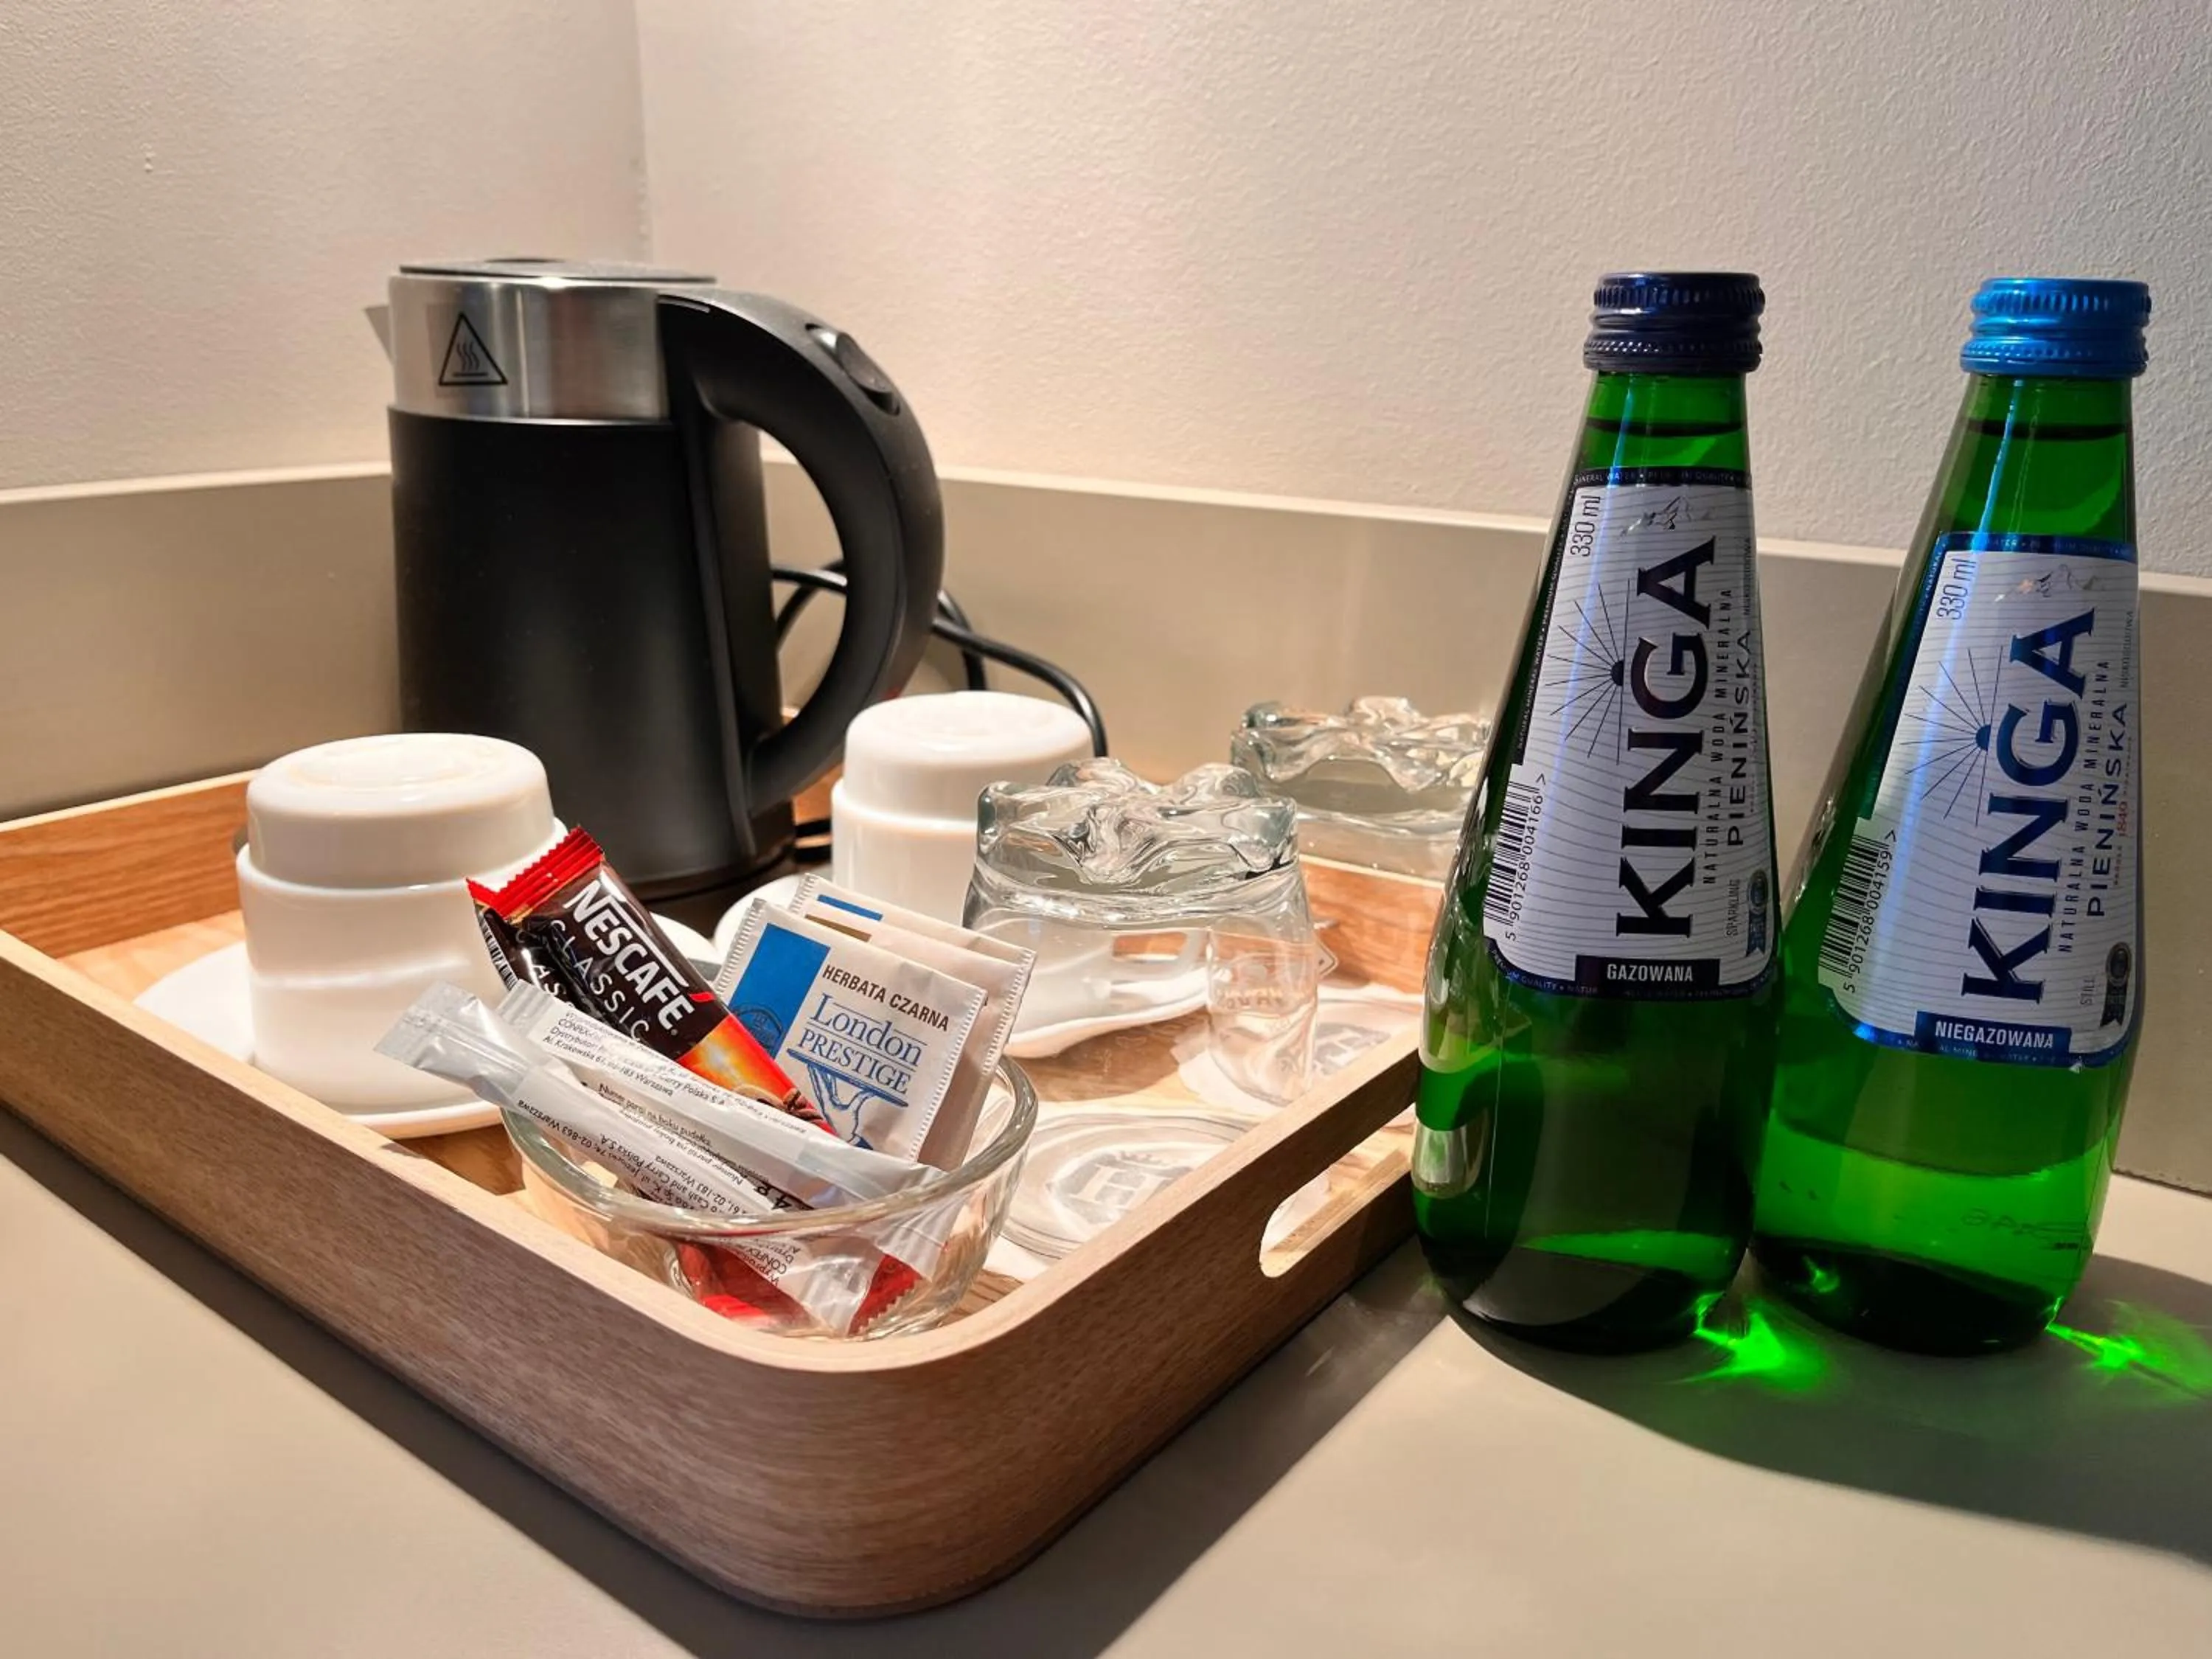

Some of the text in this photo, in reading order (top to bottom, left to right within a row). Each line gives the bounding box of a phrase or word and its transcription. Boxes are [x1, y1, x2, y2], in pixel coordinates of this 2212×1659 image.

[1571, 495, 1601, 557] 330 ml
[1935, 558, 1976, 620] 330 ml
[1616, 536, 1717, 939] KINGA
[1702, 589, 1733, 884] NATURALNA WODA MINERALNA
[1727, 630, 1753, 846] PIENIŃSKA
[1961, 608, 2096, 1005] KINGA
[2058, 661, 2110, 953] NATURALNA WODA MINERALNA
[2087, 702, 2128, 917] PIENIŃSKA
[1505, 794, 1544, 942] 5 901268 004166
[1843, 849, 1893, 994] 5 901268 004159
[551, 919, 650, 1040] CLASSIC
[822, 964, 950, 1032] HERBATA CZARNA
[1606, 961, 1694, 983] GAZOWANA
[797, 1029, 911, 1096] PRESTIGE
[810, 992, 922, 1067] London
[1935, 1020, 2054, 1050] NIEGAZOWANA
[514, 1099, 563, 1131] Warszawa
[634, 1072, 675, 1096] Warszawa
[560, 1125, 594, 1148] 02-863
[596, 1133, 711, 1210] Cash and Carry Polska S.A.
[650, 1155, 698, 1187] Warszawa
[695, 1181, 728, 1206] 02-183
